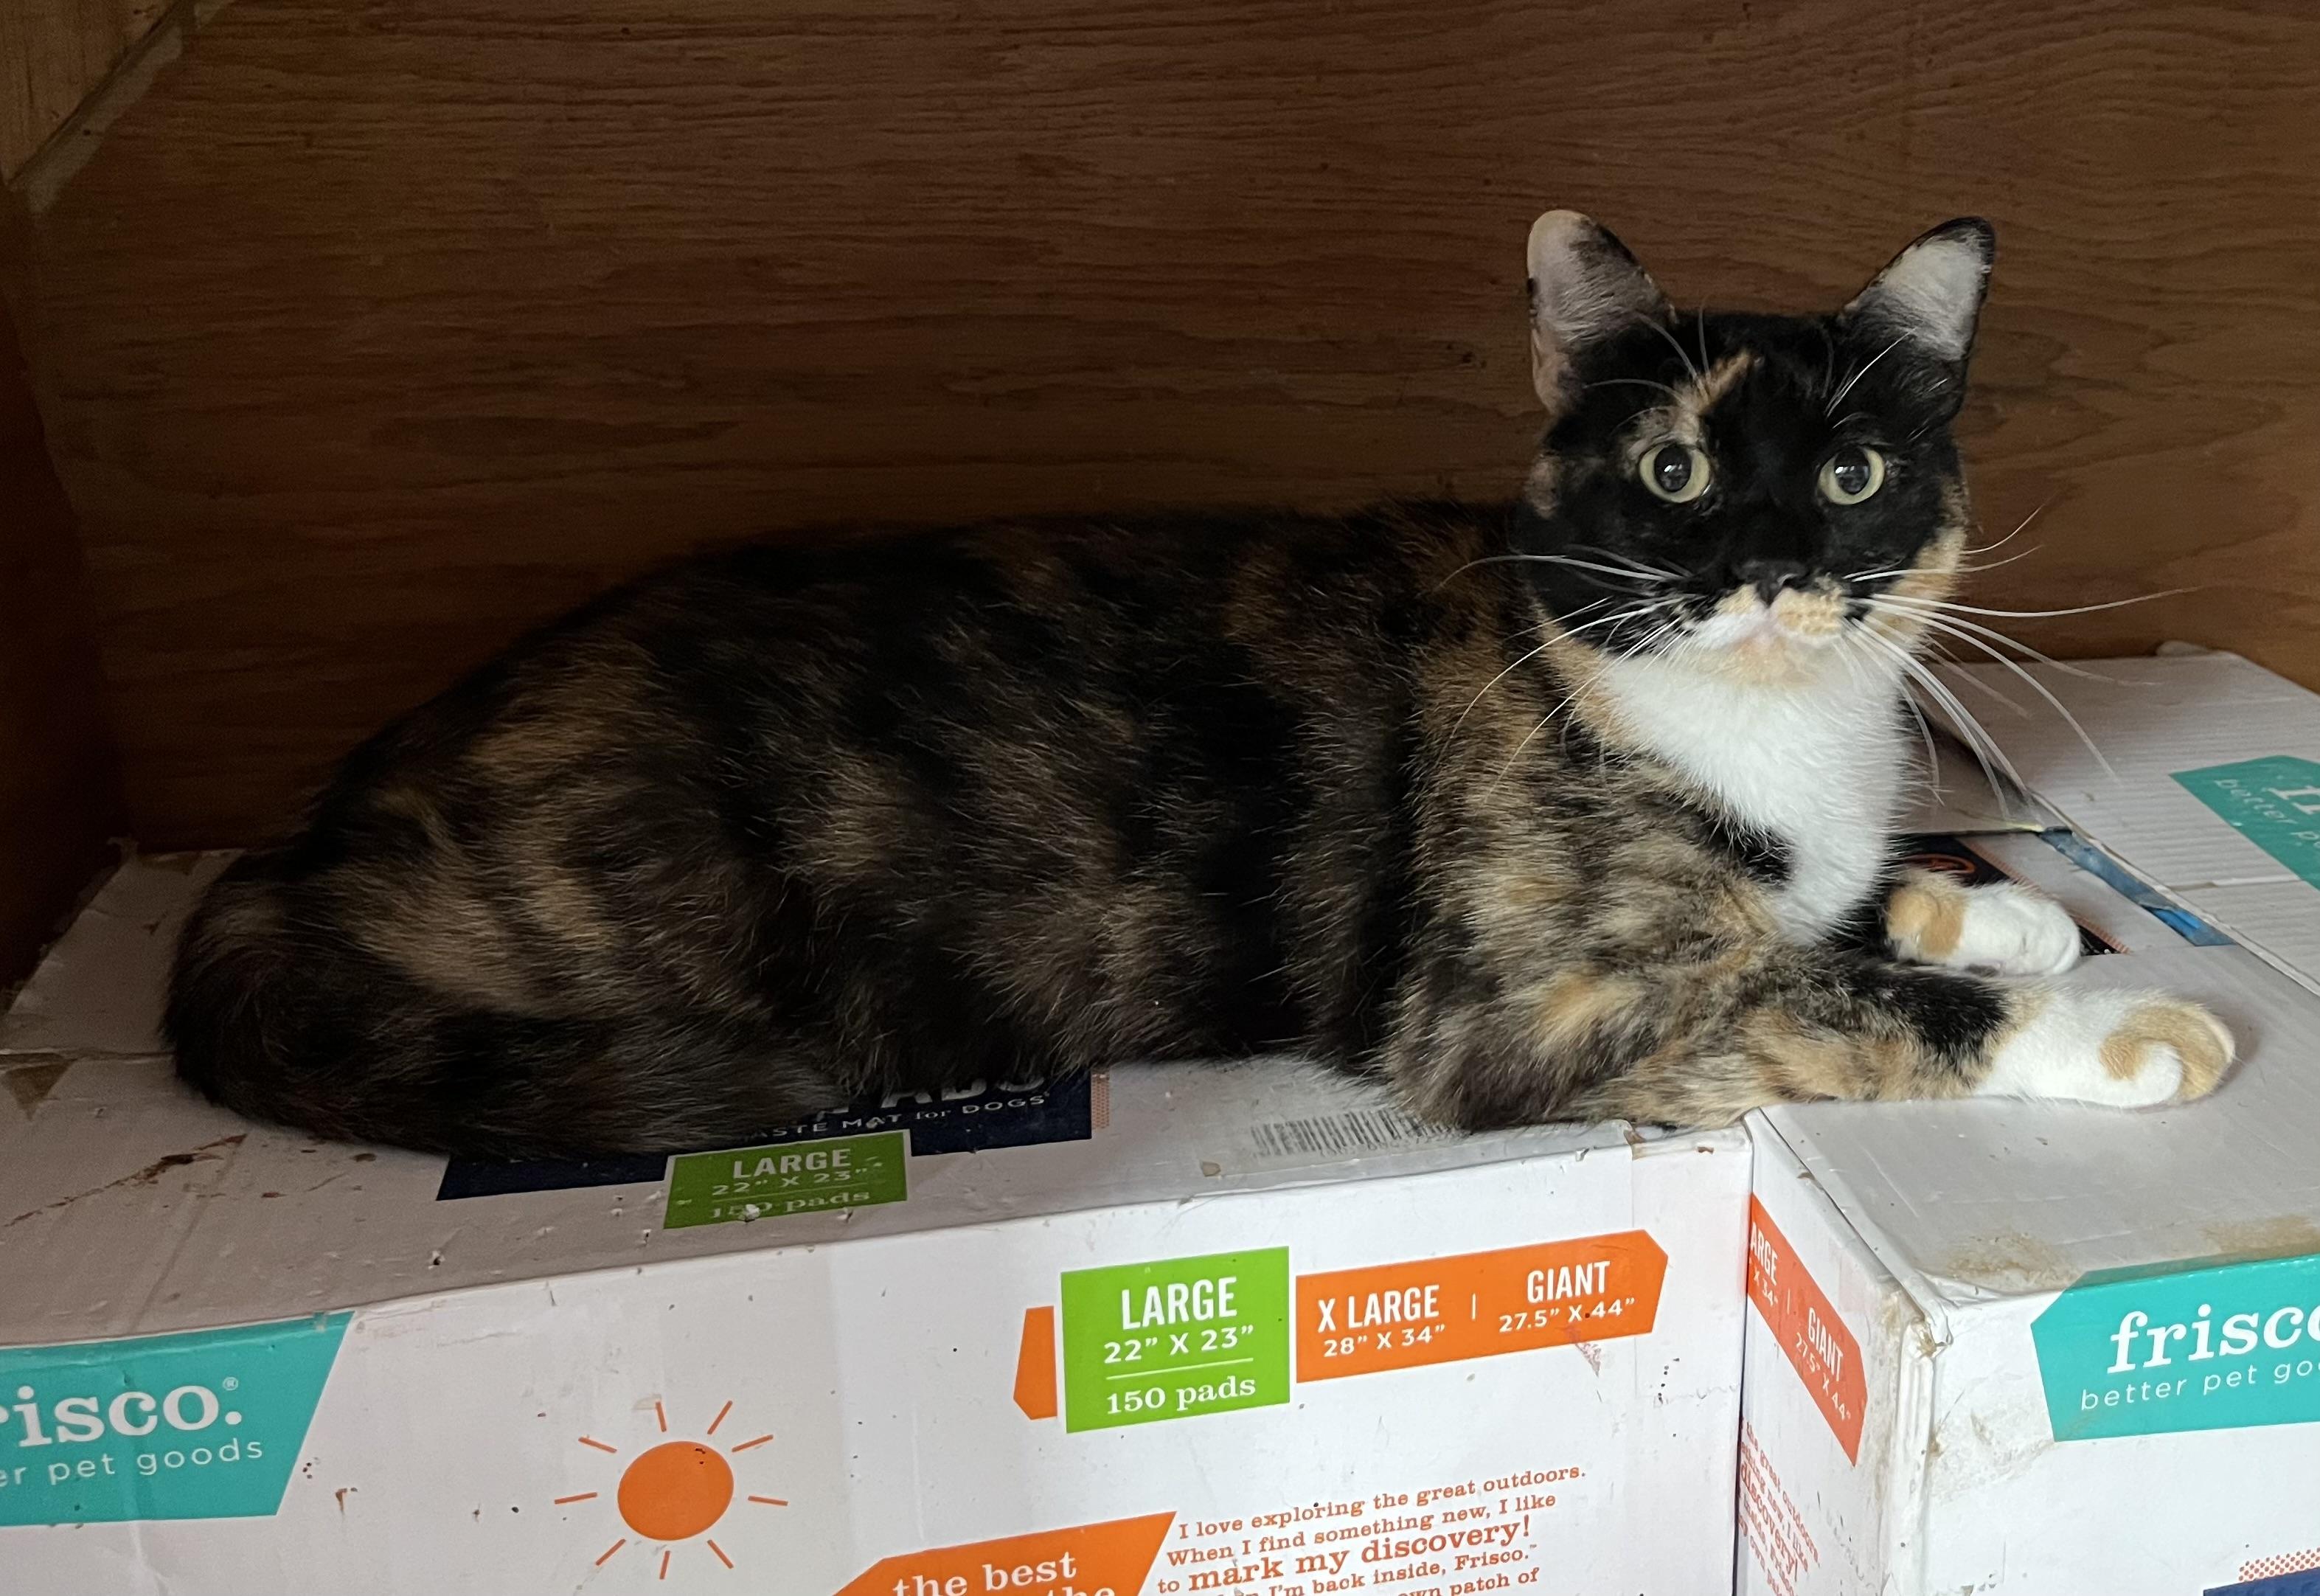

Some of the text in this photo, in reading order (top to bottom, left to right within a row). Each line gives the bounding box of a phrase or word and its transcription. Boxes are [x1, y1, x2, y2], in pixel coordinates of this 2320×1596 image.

[749, 1094, 1045, 1139] ASTE MAT for DOGS
[733, 1148, 851, 1180] LARGE
[781, 1176, 800, 1188] X
[785, 1191, 870, 1212] pads
[1121, 1276, 1237, 1330] LARGE
[1527, 1260, 1611, 1304] GIANT
[1317, 1284, 1440, 1333] X LARGE
[1568, 1304, 1583, 1322] X
[1169, 1332, 1189, 1356] X
[1376, 1330, 1392, 1350] X
[1807, 1307, 1844, 1382] GIANT
[1107, 1375, 1256, 1415] 150 pads
[1822, 1373, 1830, 1396] X
[2080, 1359, 2320, 1411] better pet go
[48, 1453, 115, 1485] pet
[136, 1437, 263, 1475] goods
[1179, 1466, 1586, 1540] I love exploring the great outdoors.
[1167, 1494, 1556, 1567] When I find something new, I like
[892, 1551, 1077, 1596] the best
[1157, 1513, 1530, 1594] to mark my discovery!
[1312, 1573, 1366, 1595] back
[1373, 1561, 1446, 1586] inside,
[1450, 1572, 1510, 1596] patch
[1518, 1566, 1540, 1584] of
